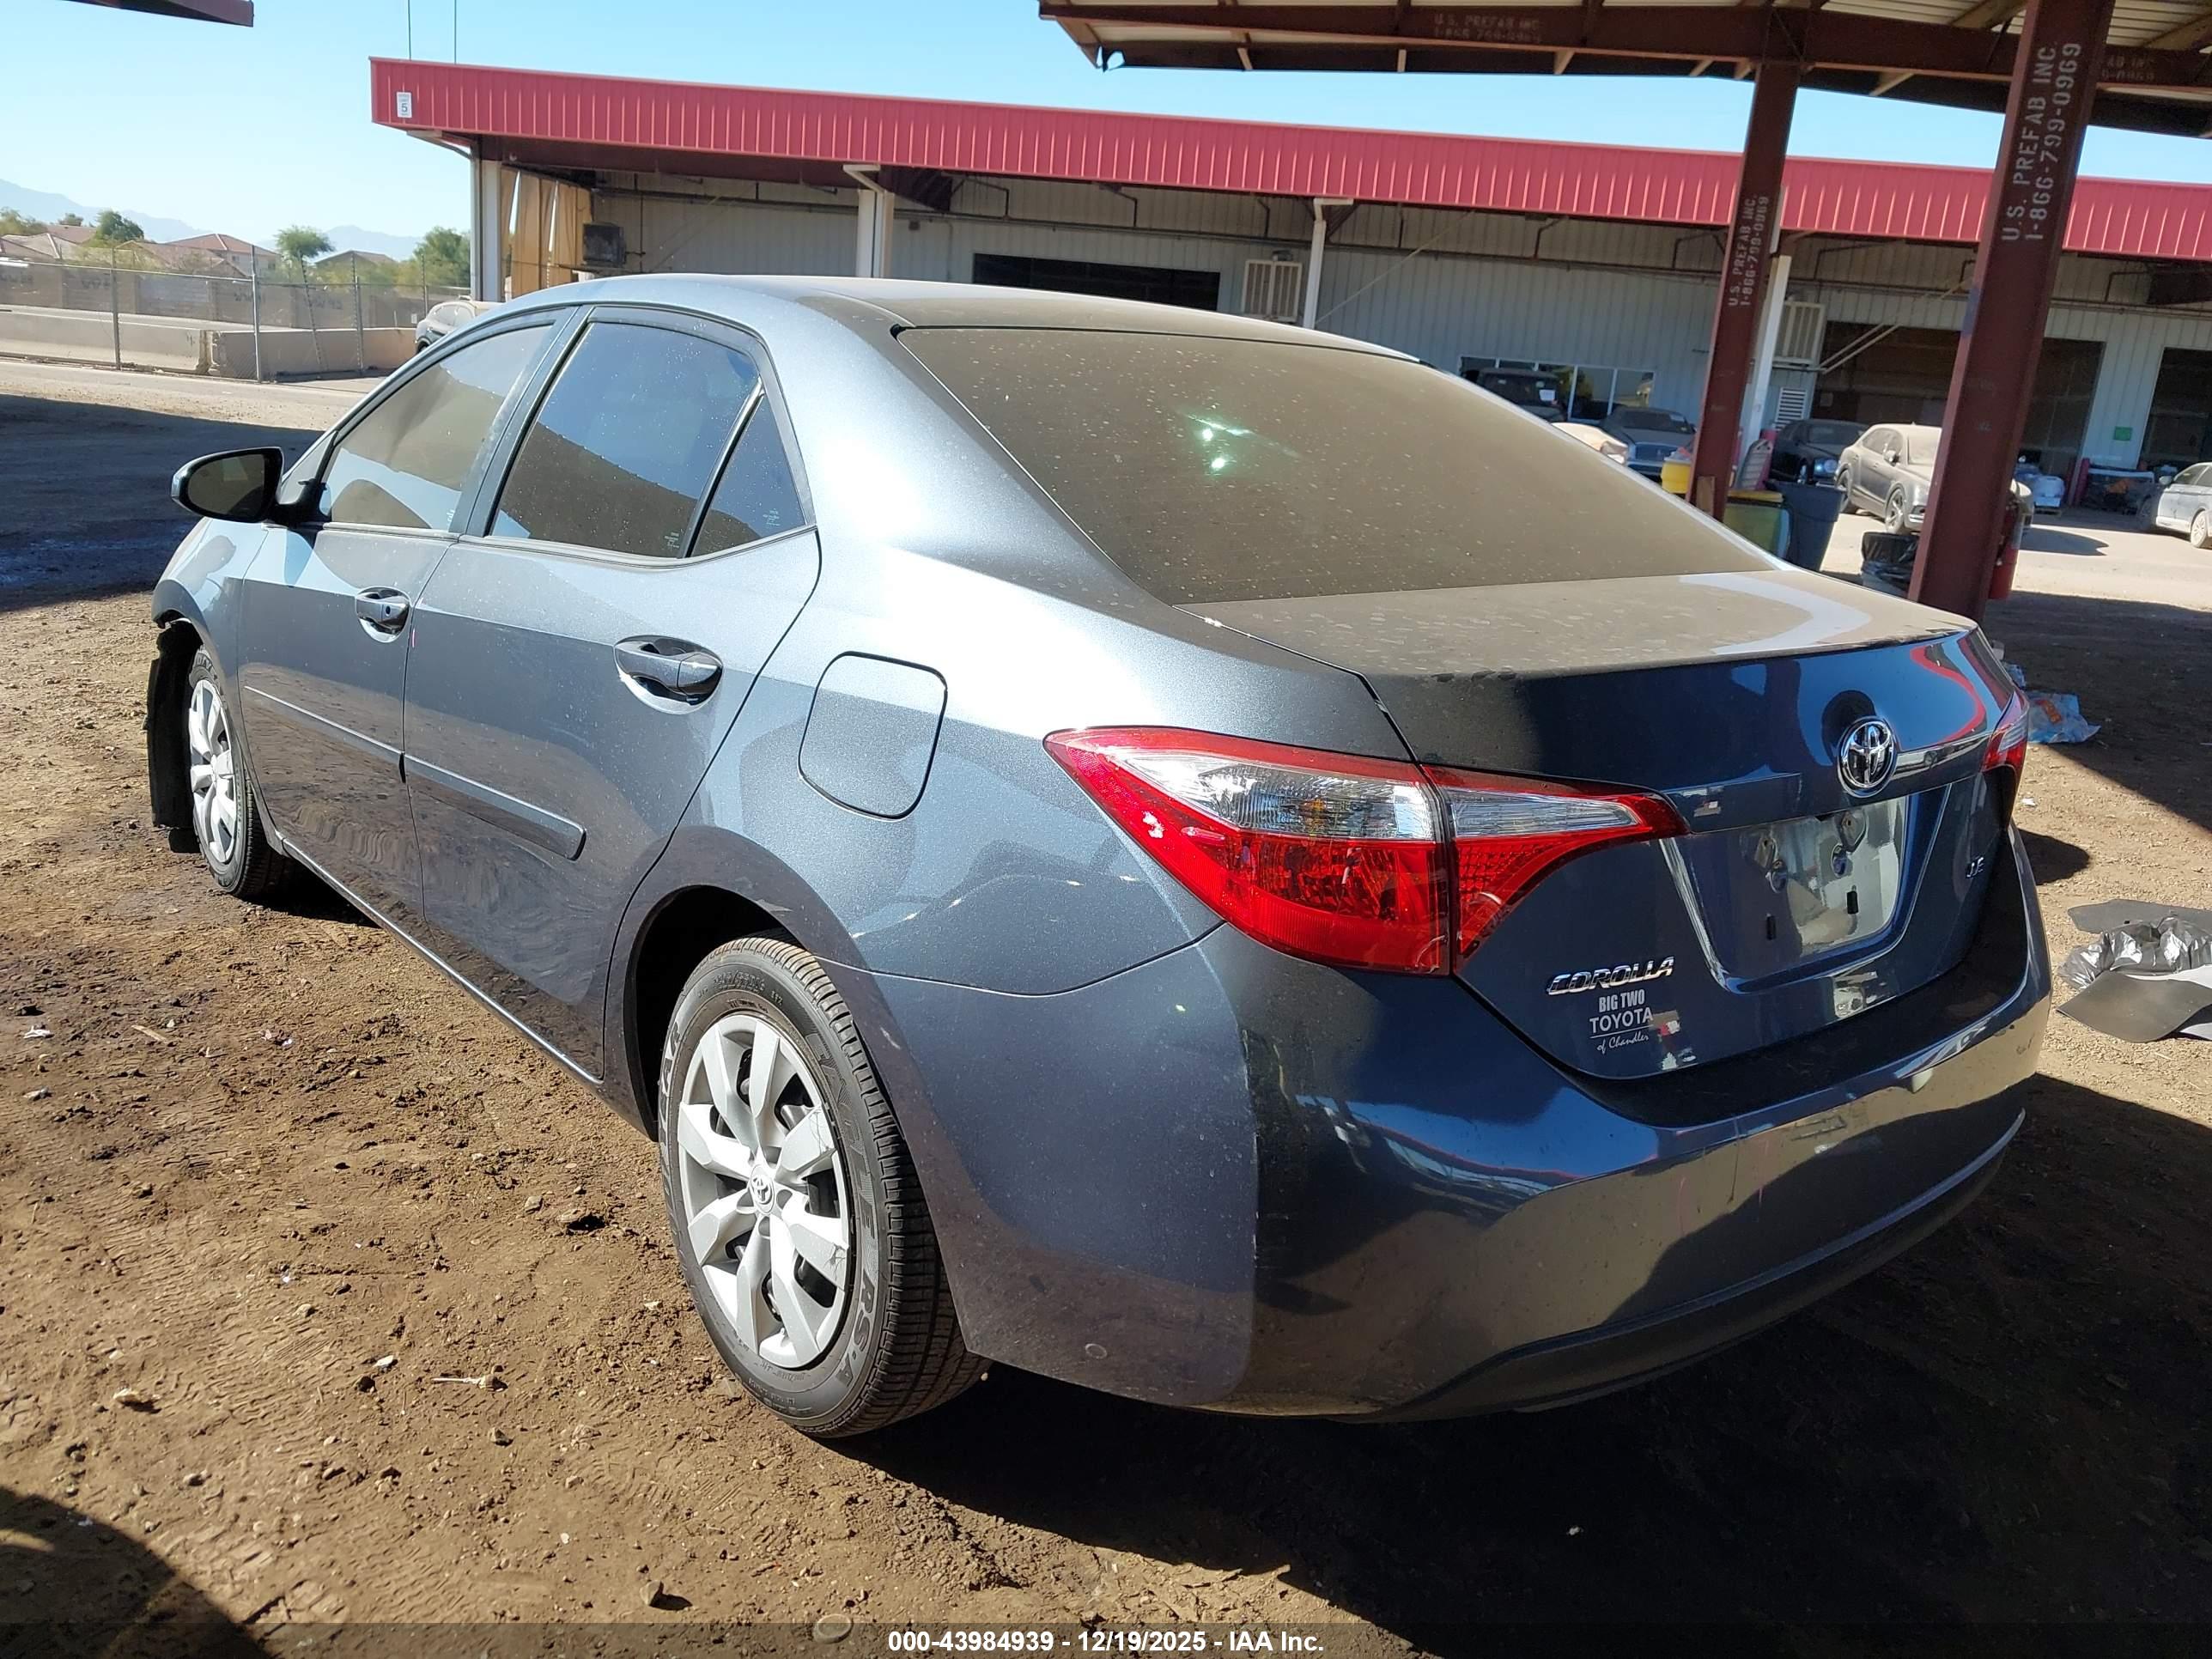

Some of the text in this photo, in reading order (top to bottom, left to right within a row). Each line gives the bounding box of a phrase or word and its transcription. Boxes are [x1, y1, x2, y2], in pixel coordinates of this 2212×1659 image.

[2012, 95, 2046, 185] PREFAB
[2025, 42, 2082, 240] 1-866-799-0969
[2002, 198, 2027, 241] U.S.
[1732, 225, 1751, 276] PREFAB
[1547, 956, 1674, 995] COROLLA
[1589, 1006, 1654, 1034] TOYOTA
[1599, 988, 1645, 1013] BIG TWO
[1596, 1030, 1650, 1055] of Chandler
